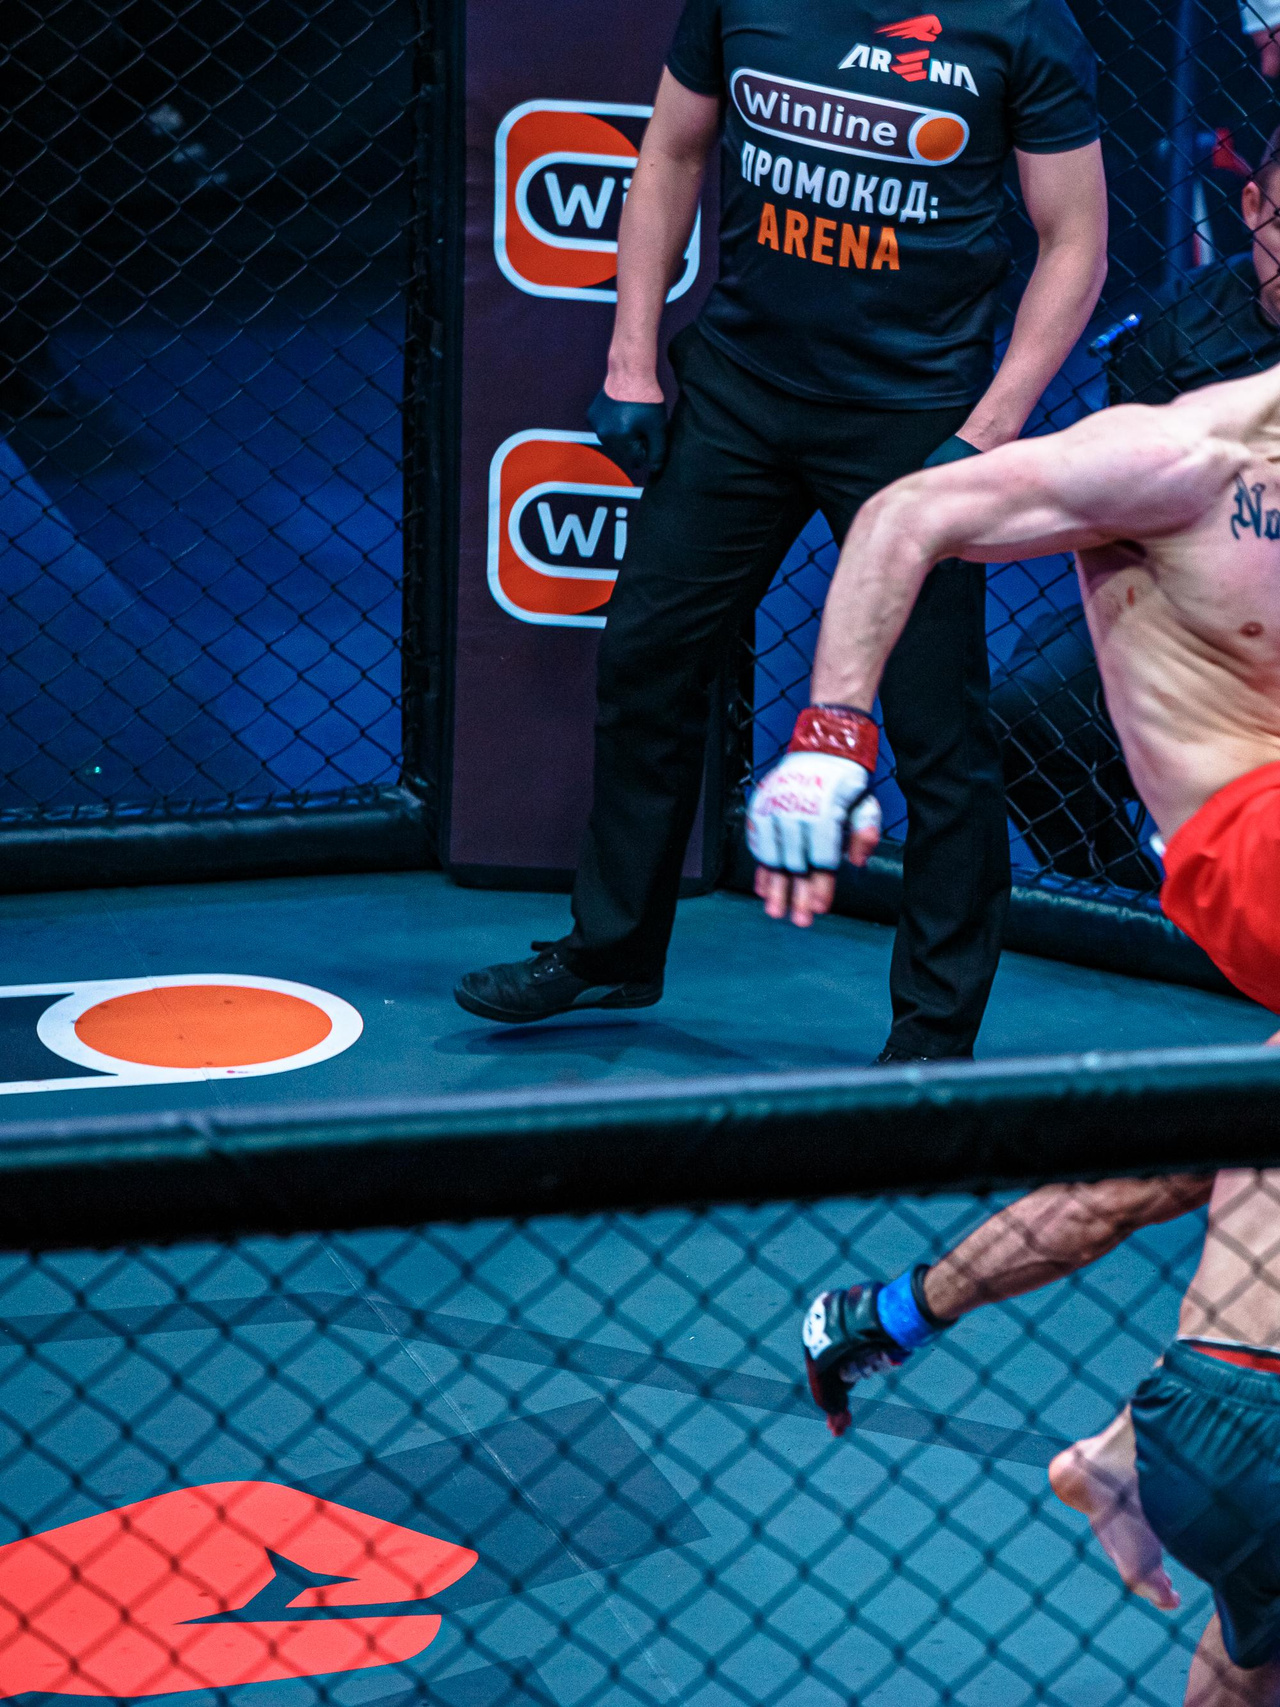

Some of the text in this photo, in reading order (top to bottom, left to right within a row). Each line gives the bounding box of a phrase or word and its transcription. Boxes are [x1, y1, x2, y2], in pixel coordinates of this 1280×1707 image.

[838, 43, 980, 97] ARENA
[742, 82, 898, 147] Winline
[741, 140, 940, 225] ПРОМОКОД:
[757, 202, 901, 271] ARENA
